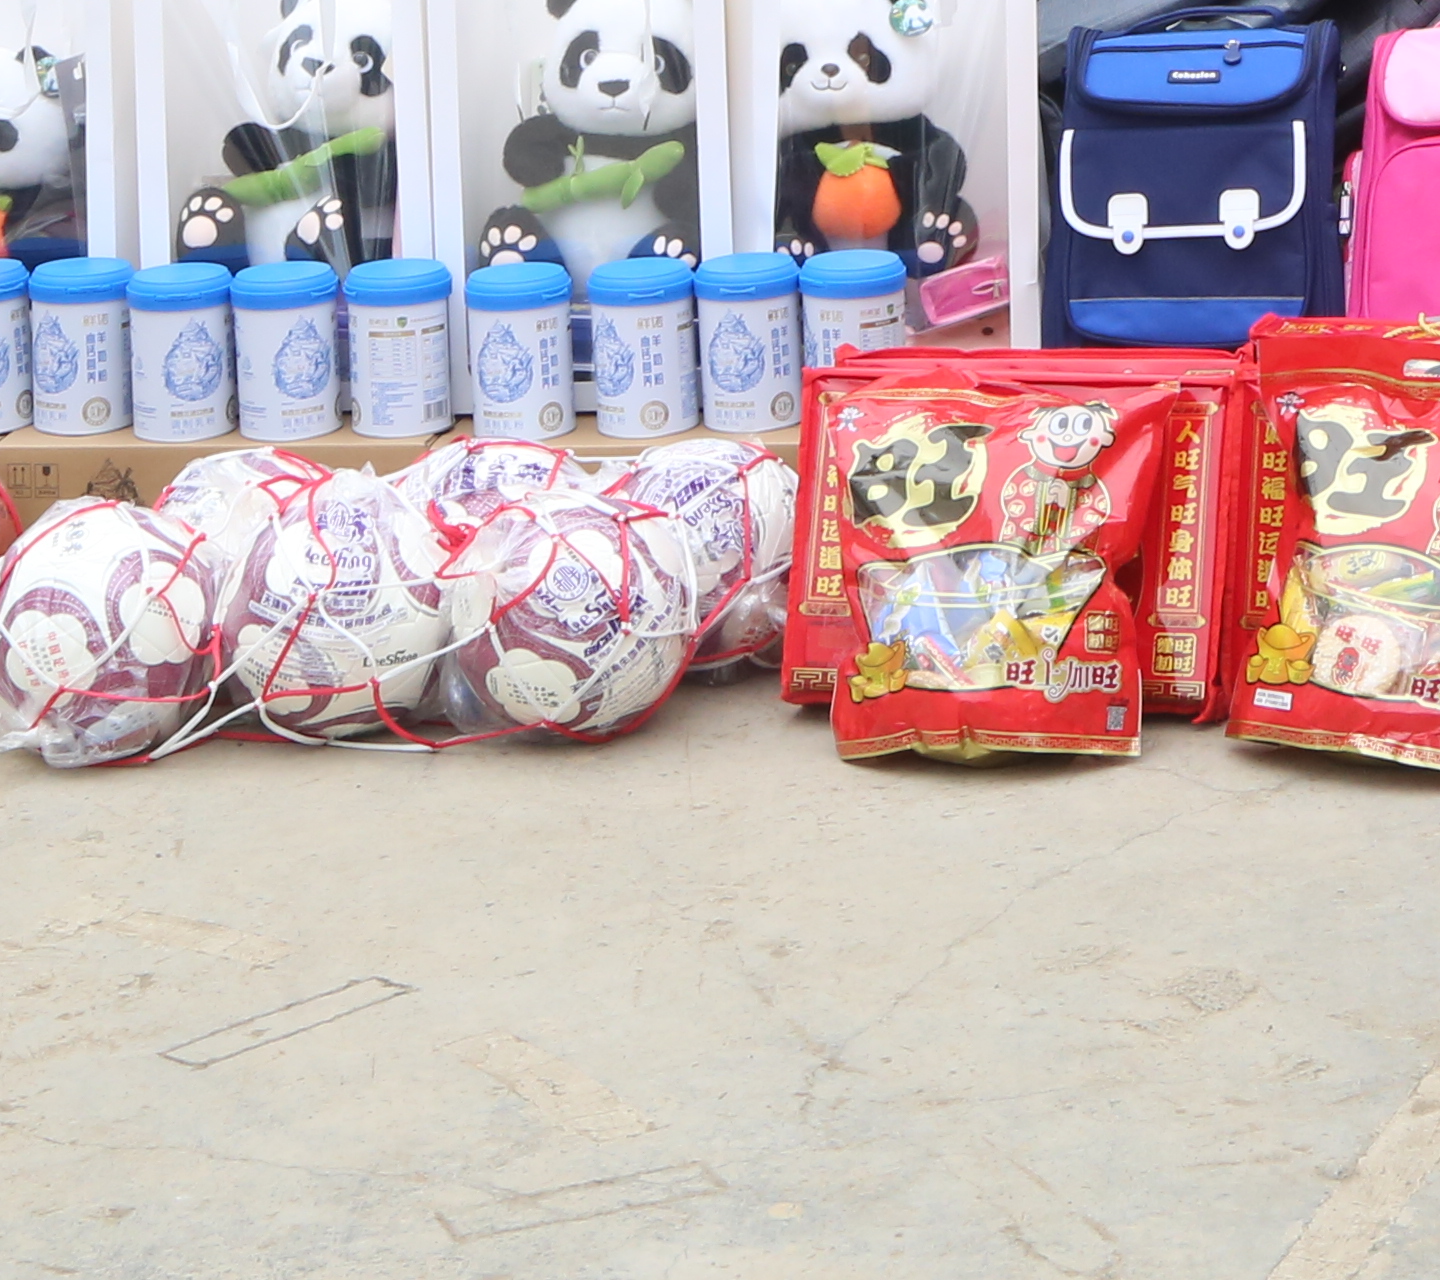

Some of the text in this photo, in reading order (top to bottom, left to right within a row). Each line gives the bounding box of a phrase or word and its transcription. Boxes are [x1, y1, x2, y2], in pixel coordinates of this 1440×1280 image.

[1171, 70, 1217, 81] Cohesion
[1166, 421, 1202, 608] 人旺气旺身体旺
